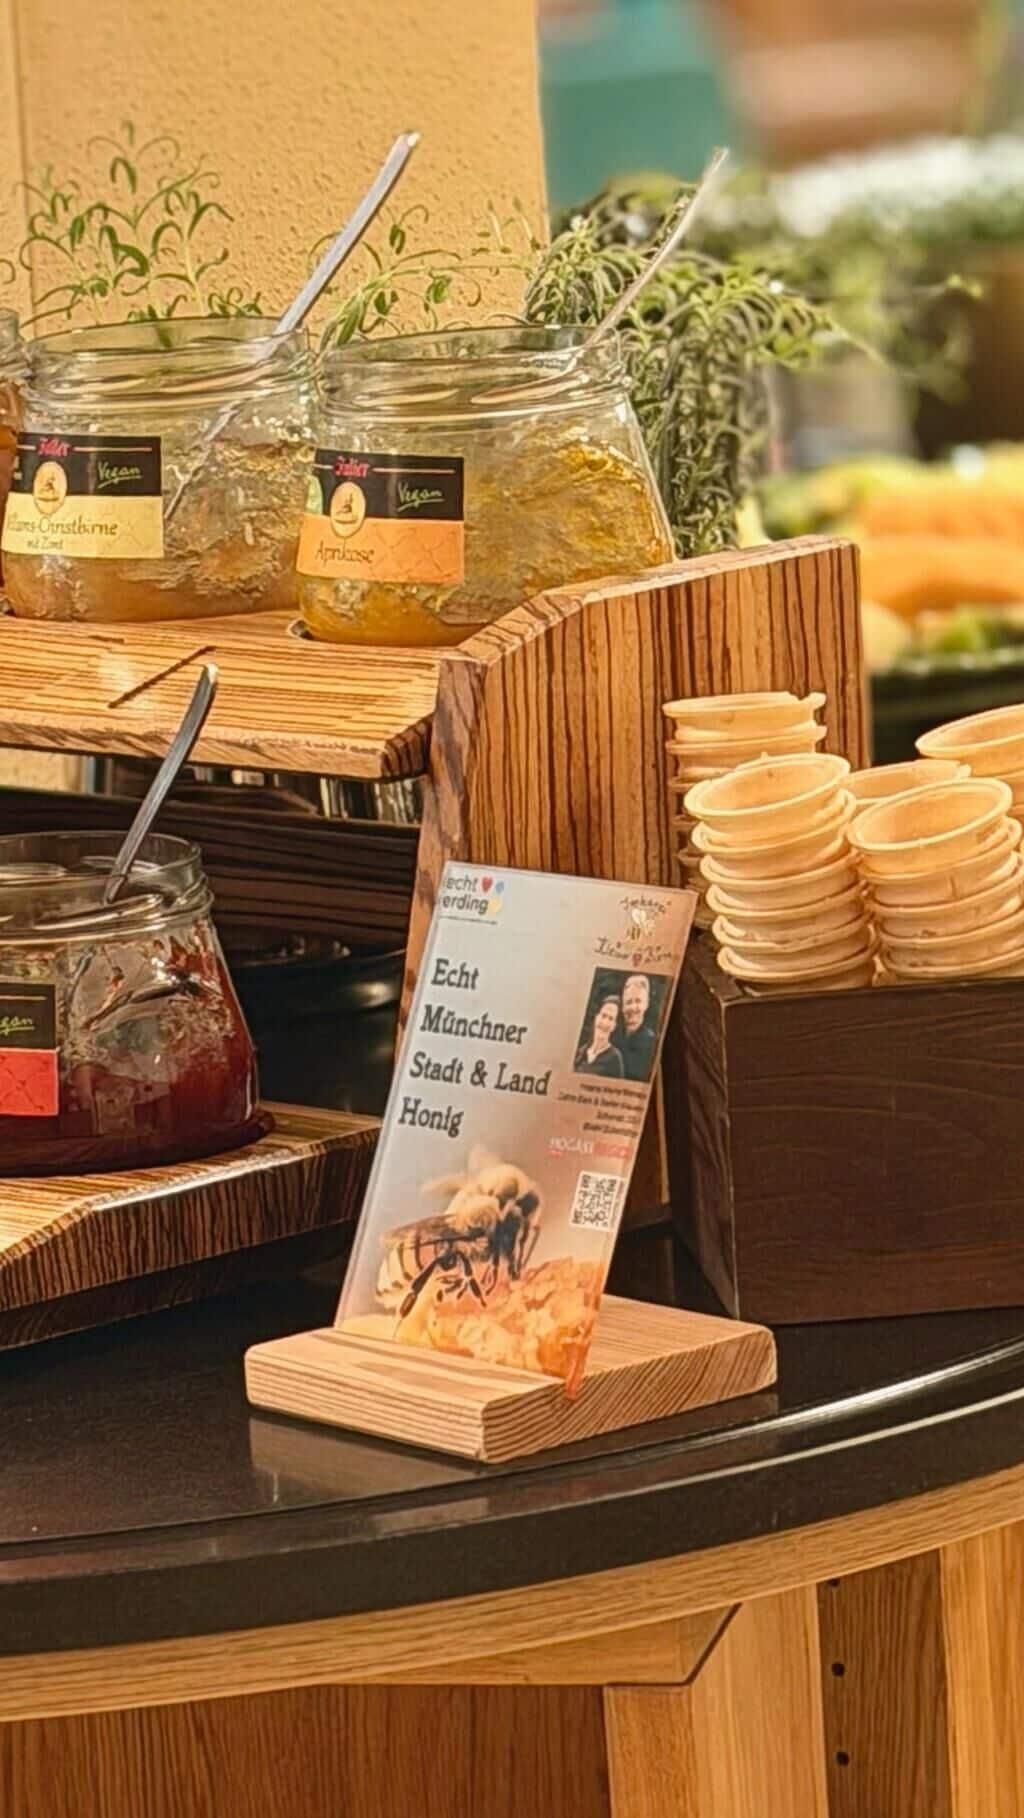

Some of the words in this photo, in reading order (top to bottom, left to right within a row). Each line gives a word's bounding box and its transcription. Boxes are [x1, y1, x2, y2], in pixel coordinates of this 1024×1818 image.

[97, 461, 142, 484] Vegan
[397, 481, 444, 508] Vegan
[315, 540, 374, 564] Aprikose
[446, 874, 478, 892] echt
[442, 893, 489, 915] erding
[431, 958, 479, 990] Echt
[420, 1004, 528, 1044] Münchner
[409, 1051, 464, 1084] Stadt
[470, 1059, 488, 1088] &
[494, 1062, 553, 1096] Land
[398, 1097, 464, 1138] Honig
